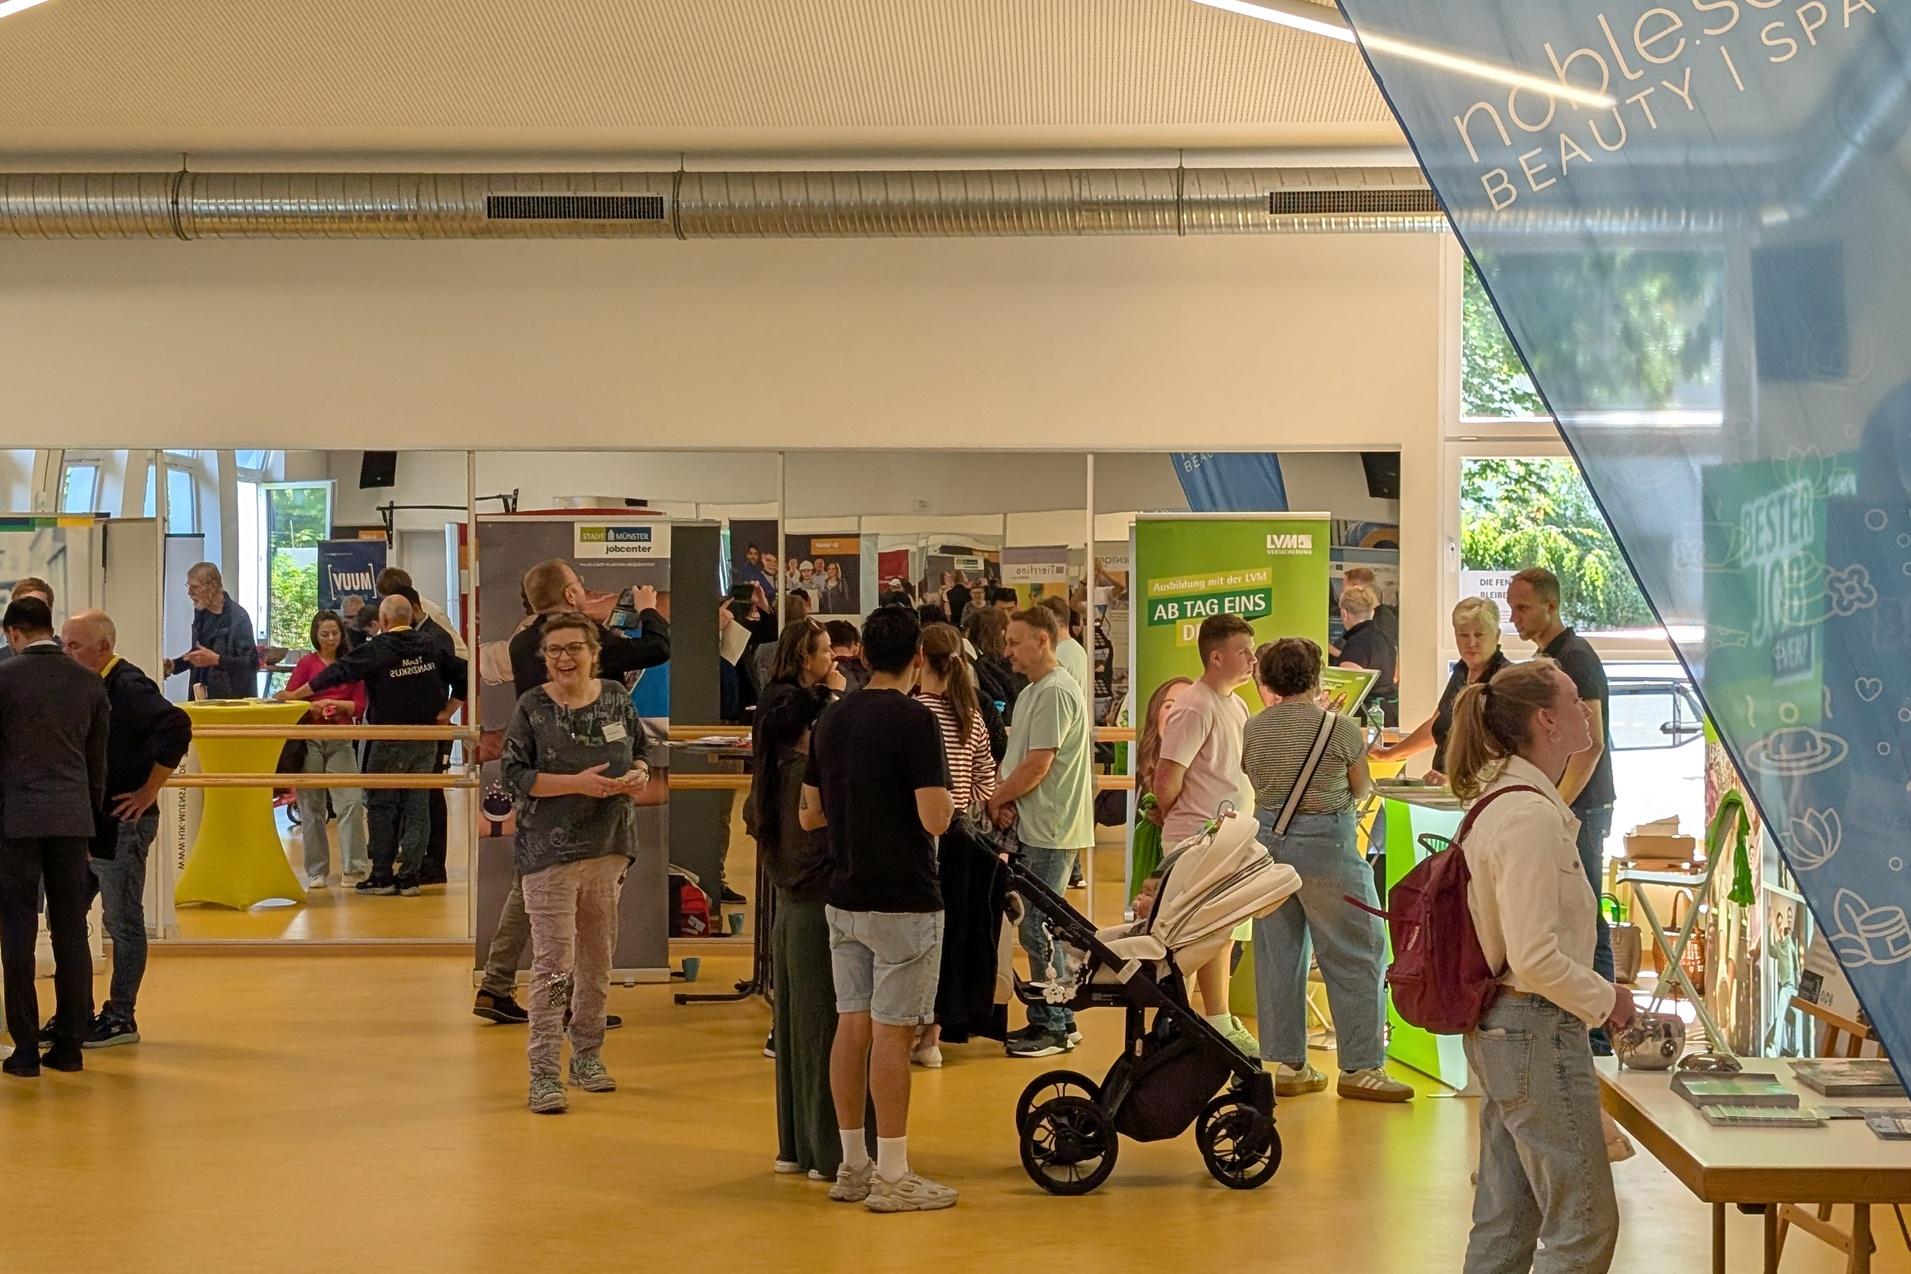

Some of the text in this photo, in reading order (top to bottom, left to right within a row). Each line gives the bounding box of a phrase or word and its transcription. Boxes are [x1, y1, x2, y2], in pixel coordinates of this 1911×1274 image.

[1481, 67, 1694, 211] BEAUTY
[1760, 0, 1877, 63] SPA
[1741, 479, 1815, 569] BESTER
[582, 531, 649, 540] STADT MÜNSTER
[1266, 534, 1298, 549] LVM
[605, 544, 652, 555] jobcenter
[1153, 571, 1267, 592] Ausbildung mit der LVM
[1479, 578, 1494, 587] DIE
[1153, 593, 1266, 621] AB TAG EINS
